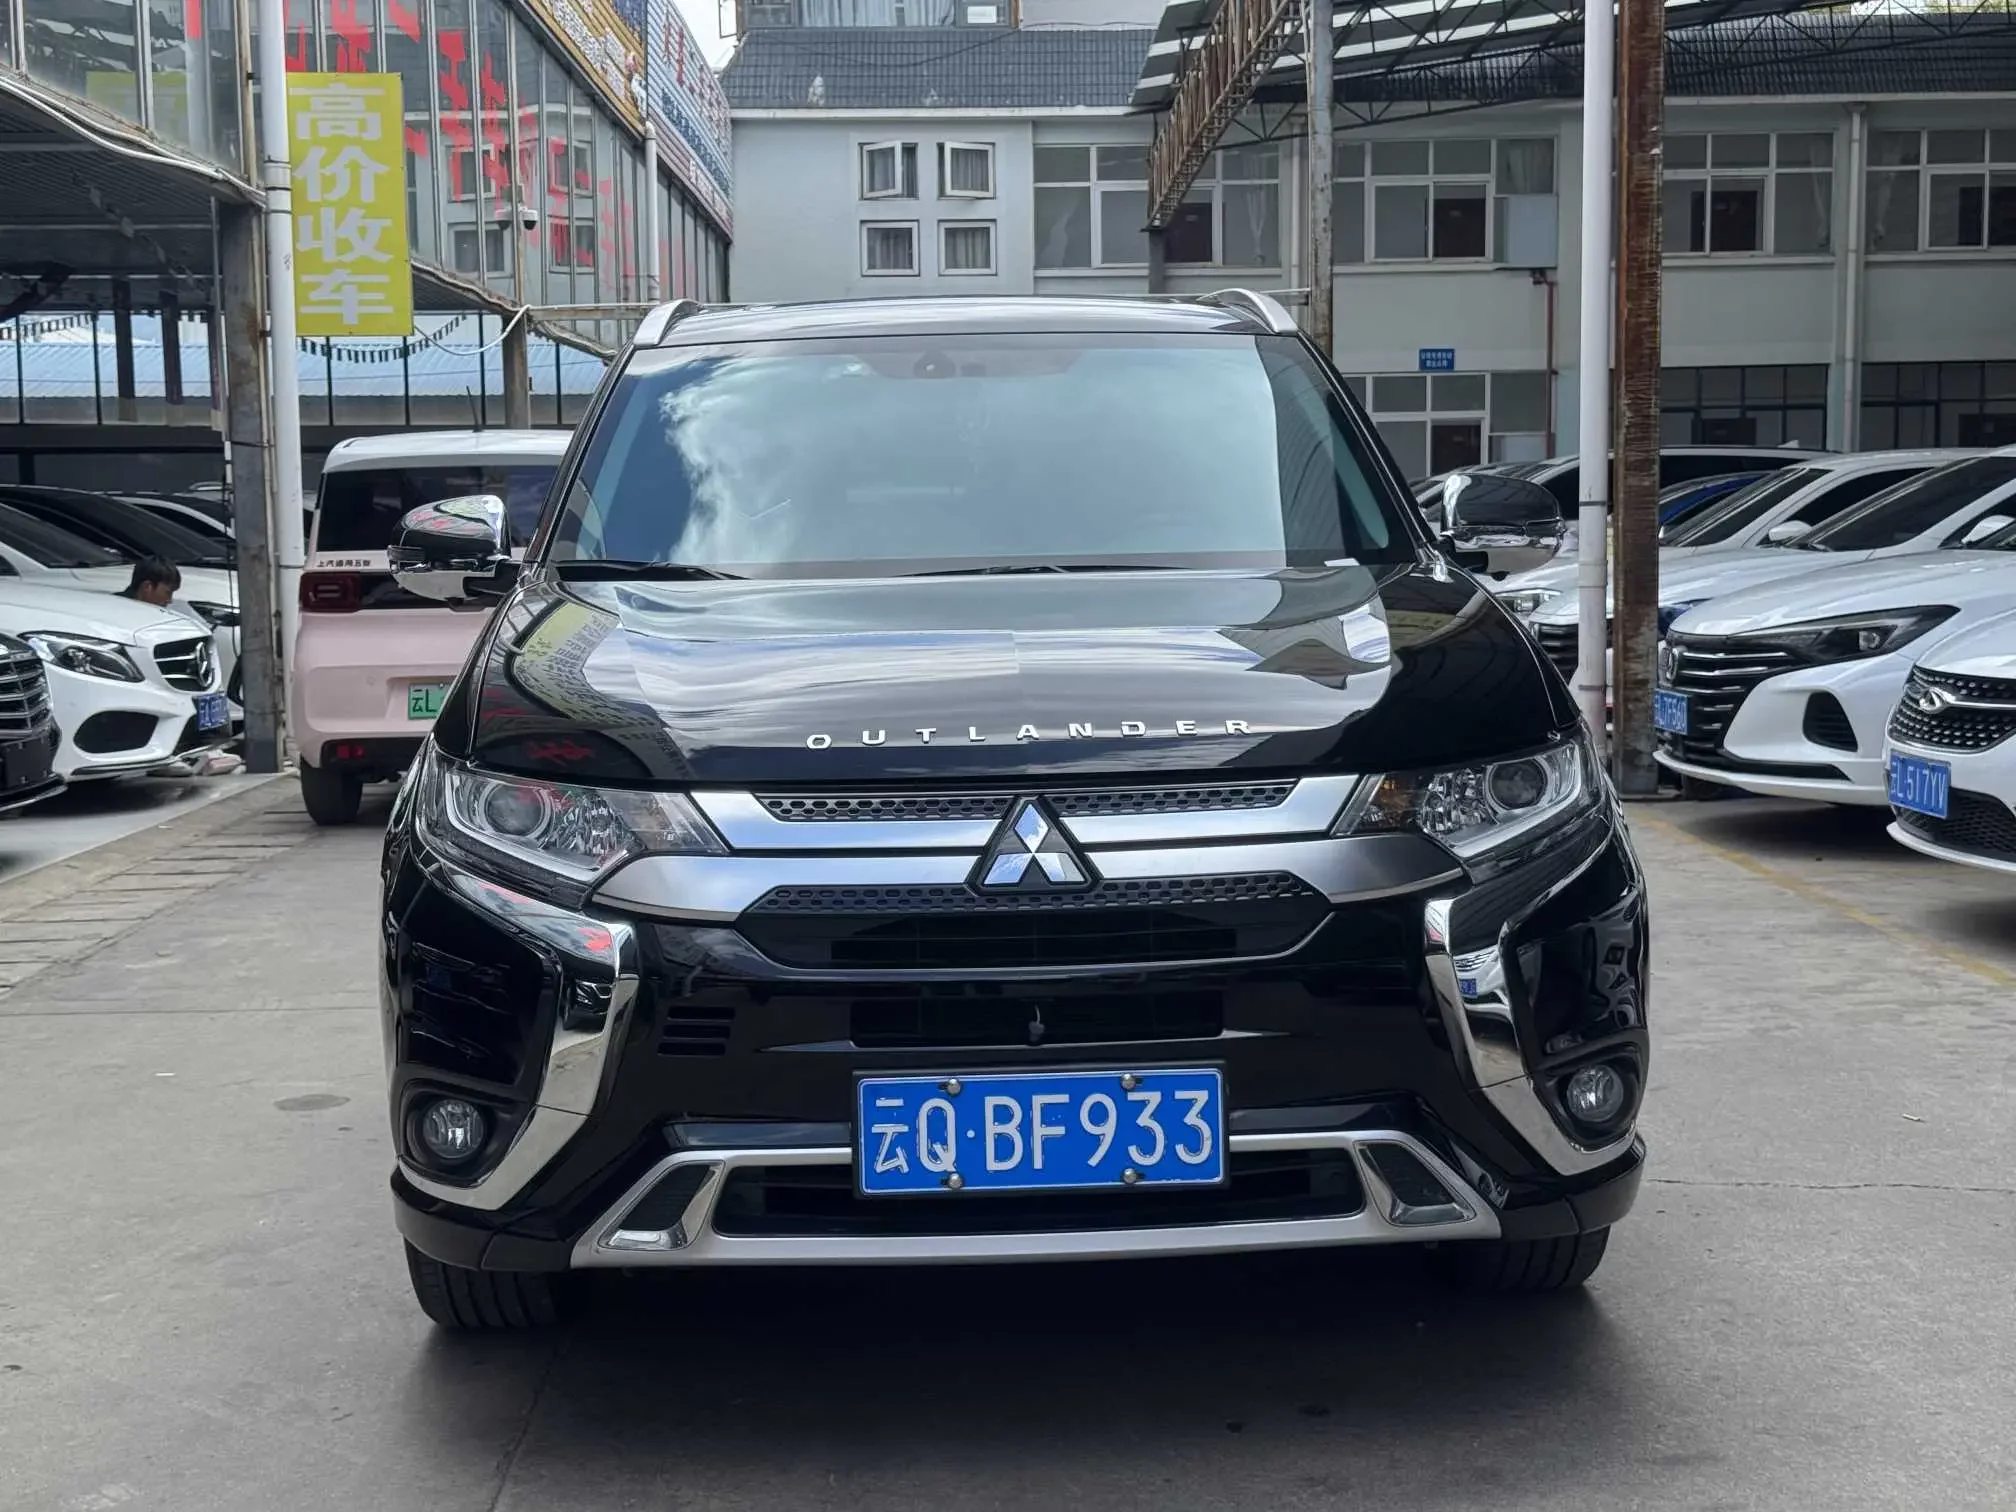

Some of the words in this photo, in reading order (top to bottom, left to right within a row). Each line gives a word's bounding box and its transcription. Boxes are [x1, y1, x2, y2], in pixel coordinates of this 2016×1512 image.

[288, 82, 395, 325] 高价收车
[806, 719, 1252, 750] OUTLANDER
[871, 1090, 1213, 1174] 云Q·BF933
